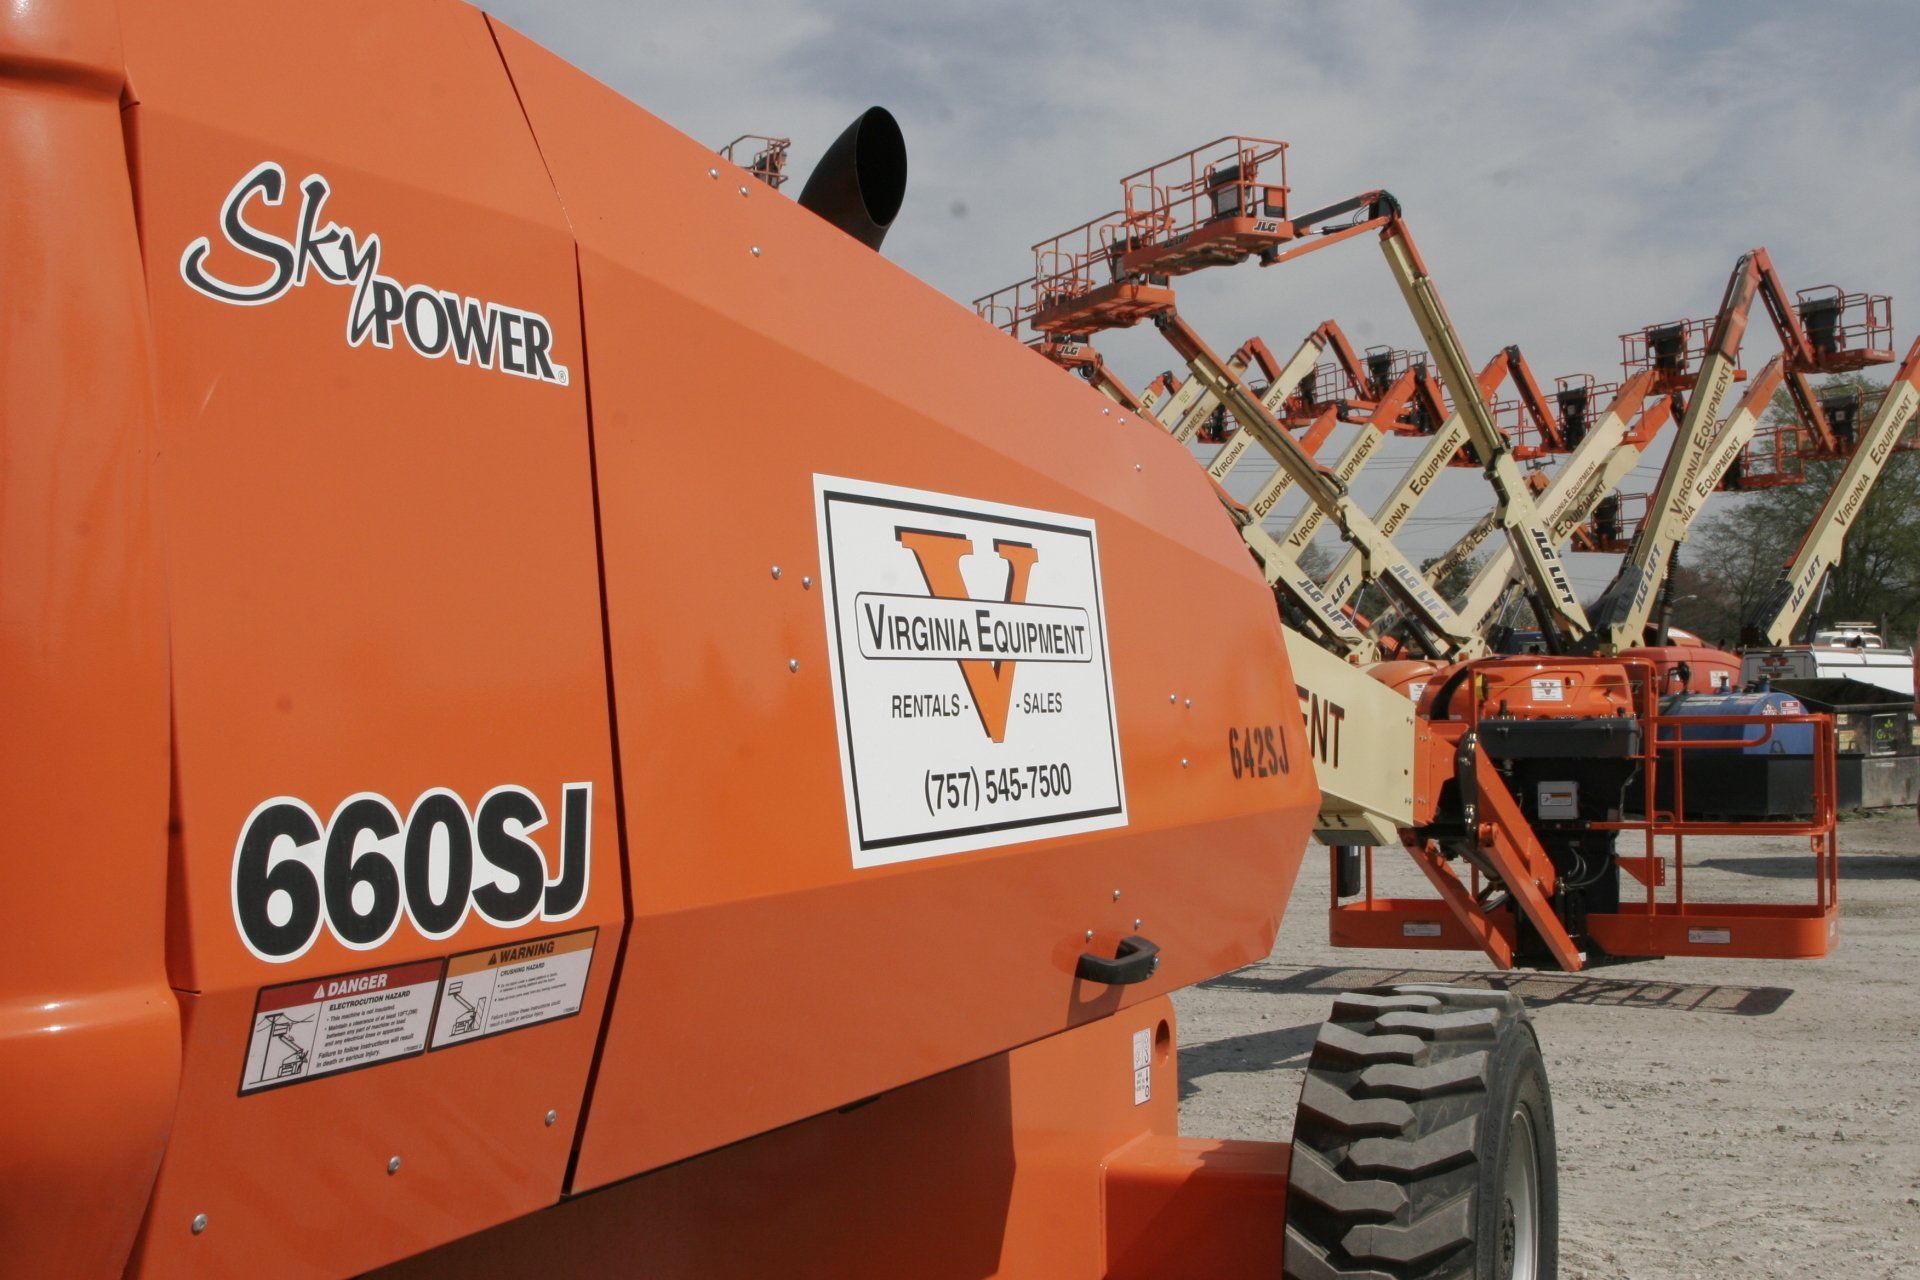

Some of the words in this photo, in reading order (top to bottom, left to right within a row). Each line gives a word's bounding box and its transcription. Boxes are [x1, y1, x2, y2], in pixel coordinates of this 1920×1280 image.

[1253, 220, 1277, 233] JLG
[182, 162, 380, 346] Sky
[372, 278, 557, 382] POWER
[1058, 346, 1079, 356] JLG
[1212, 441, 1244, 478] VIRGINIA
[1409, 428, 1461, 496] EQUIPMENT
[1669, 450, 1702, 515] VIRGINIA
[1693, 362, 1730, 451] EQUIPMENT
[1834, 474, 1870, 527] VIRGINIA
[1870, 394, 1912, 466] EQUIPMENT
[1696, 436, 1740, 498] EQUIPMENT
[1555, 481, 1607, 538] EQUIPMENT
[1332, 575, 1350, 605] LIFT
[1391, 564, 1420, 588] JLG
[1417, 590, 1449, 619] LIFT
[1531, 528, 1555, 560] JLG
[1549, 566, 1575, 604] LIFT
[1635, 581, 1649, 613] JLG
[1644, 543, 1661, 582] LIFT
[1790, 587, 1805, 613] JLG
[1804, 555, 1821, 583] LIFT
[864, 603, 978, 651] VIRGINIA
[976, 609, 1085, 654] EQUIPMENT
[1297, 580, 1324, 602] JLG
[1321, 603, 1352, 631] LIFT
[892, 694, 960, 718] RENTALS
[1024, 692, 1062, 713] SALES
[1229, 726, 1289, 779] 642SJ
[925, 766, 980, 816] (757)
[986, 763, 1071, 804] 545-7500
[233, 783, 592, 961] 660SJ
[500, 941, 555, 963] WARNING
[328, 973, 388, 997] DANGER
[329, 995, 383, 1011] ELECTROCUTION
[385, 990, 410, 1000] HAZARD
